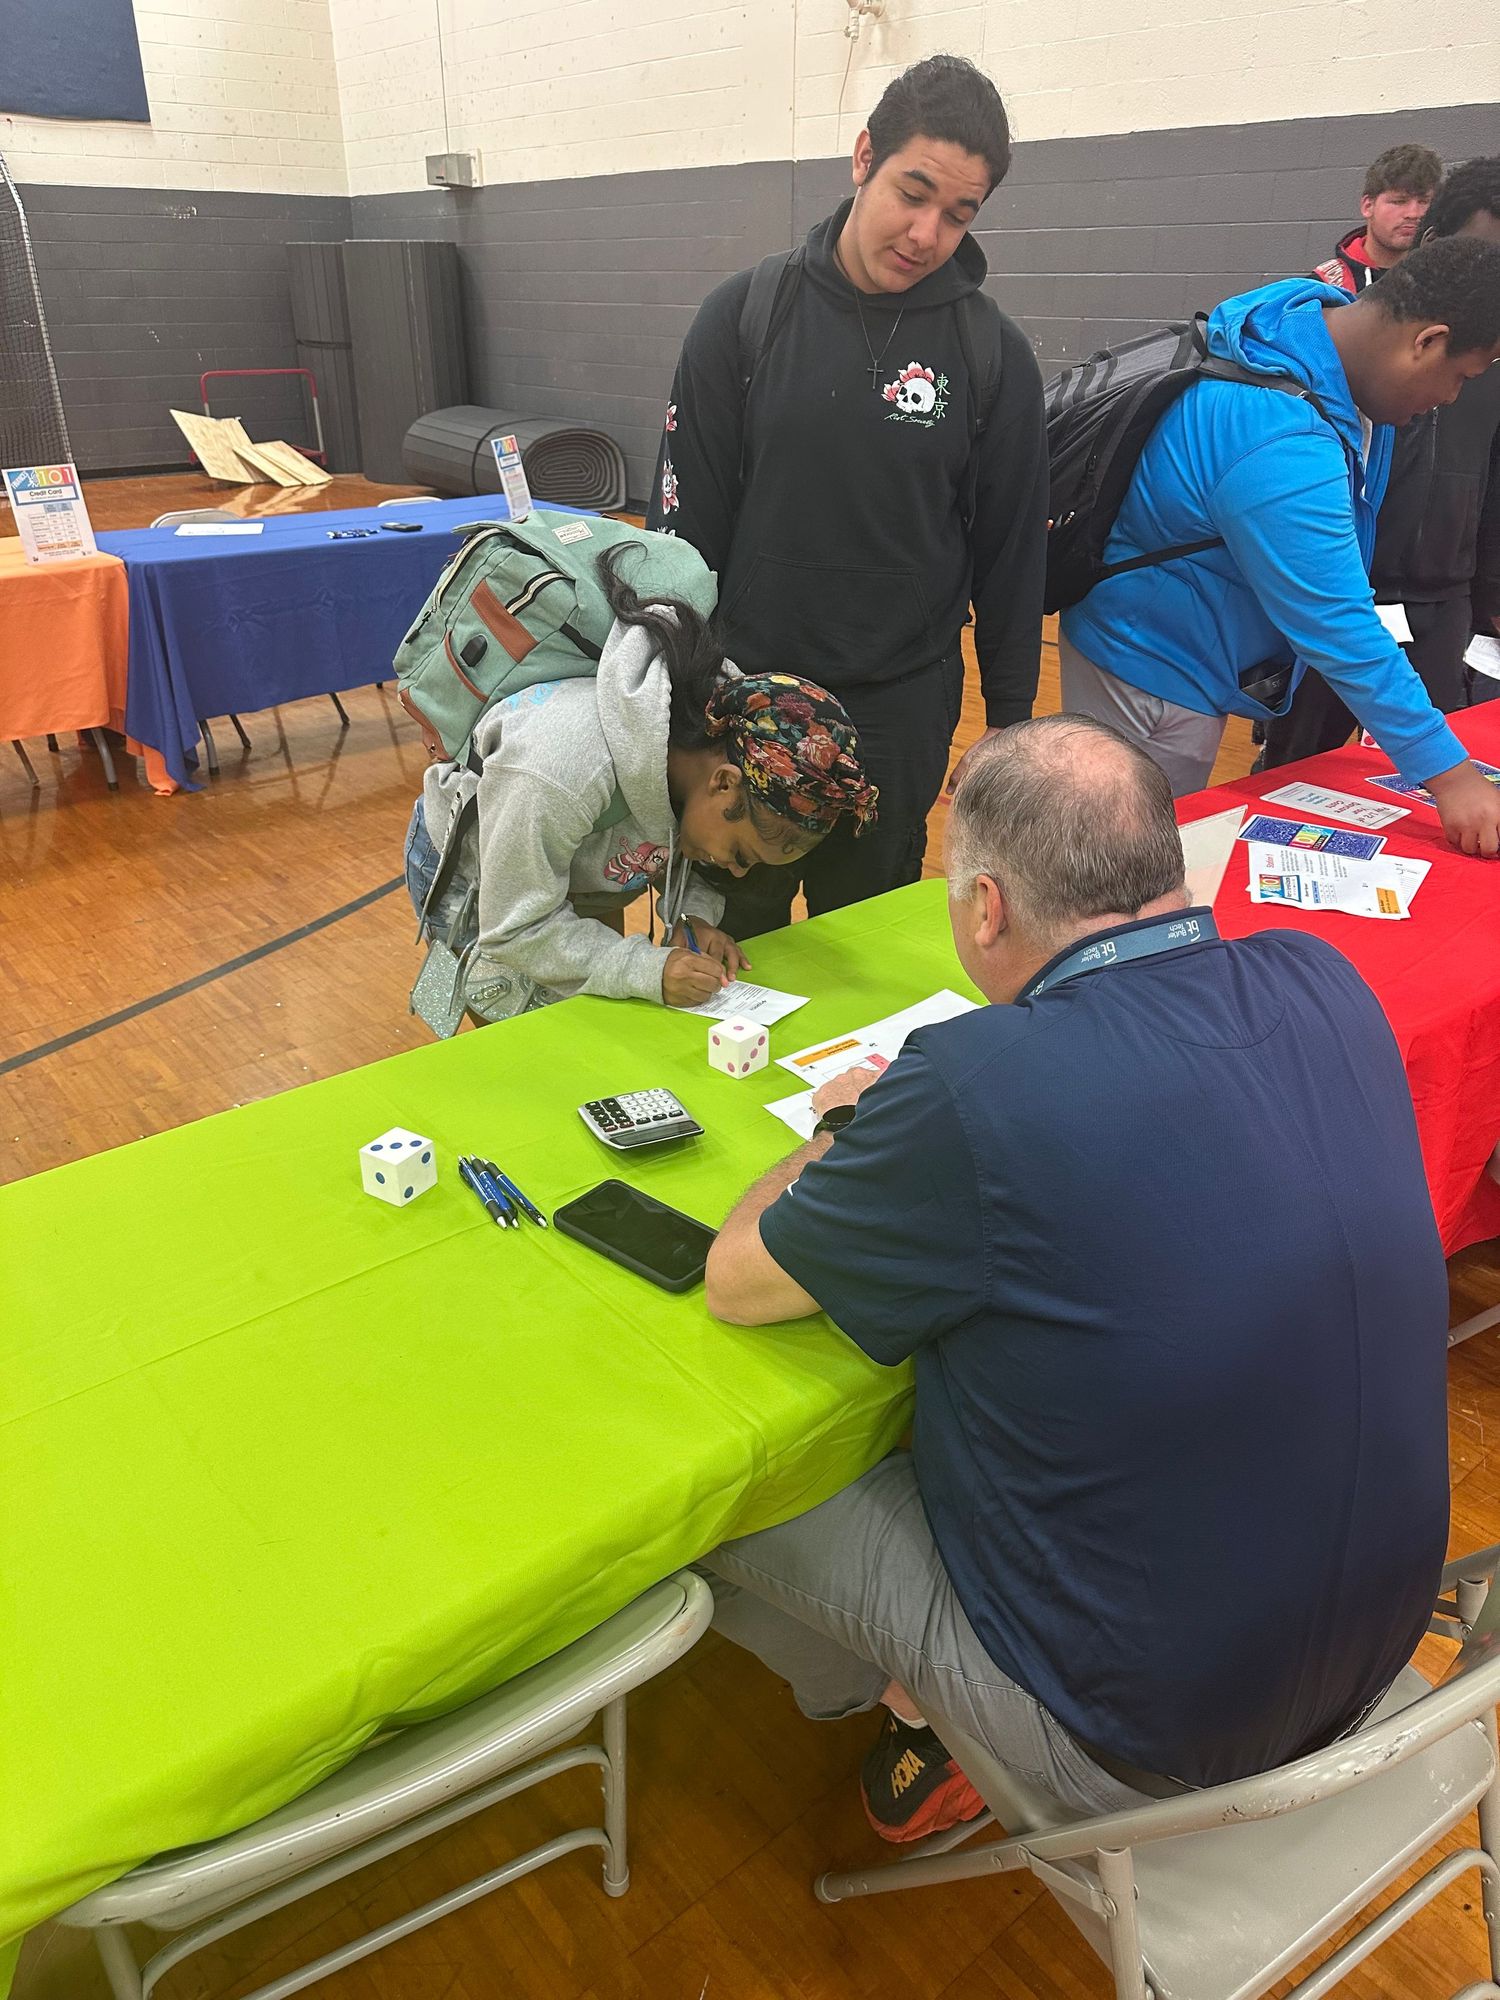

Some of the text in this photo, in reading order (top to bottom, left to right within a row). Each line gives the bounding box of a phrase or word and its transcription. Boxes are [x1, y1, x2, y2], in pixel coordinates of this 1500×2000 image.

[933, 373, 951, 419] 東京
[39, 469, 72, 487] 101
[48, 488, 63, 496] Card
[1169, 922, 1185, 932] Tech
[1168, 928, 1188, 939] Butler
[1083, 945, 1099, 955] Tech
[1081, 951, 1101, 963] Butler
[891, 1749, 926, 1798] HOKA
